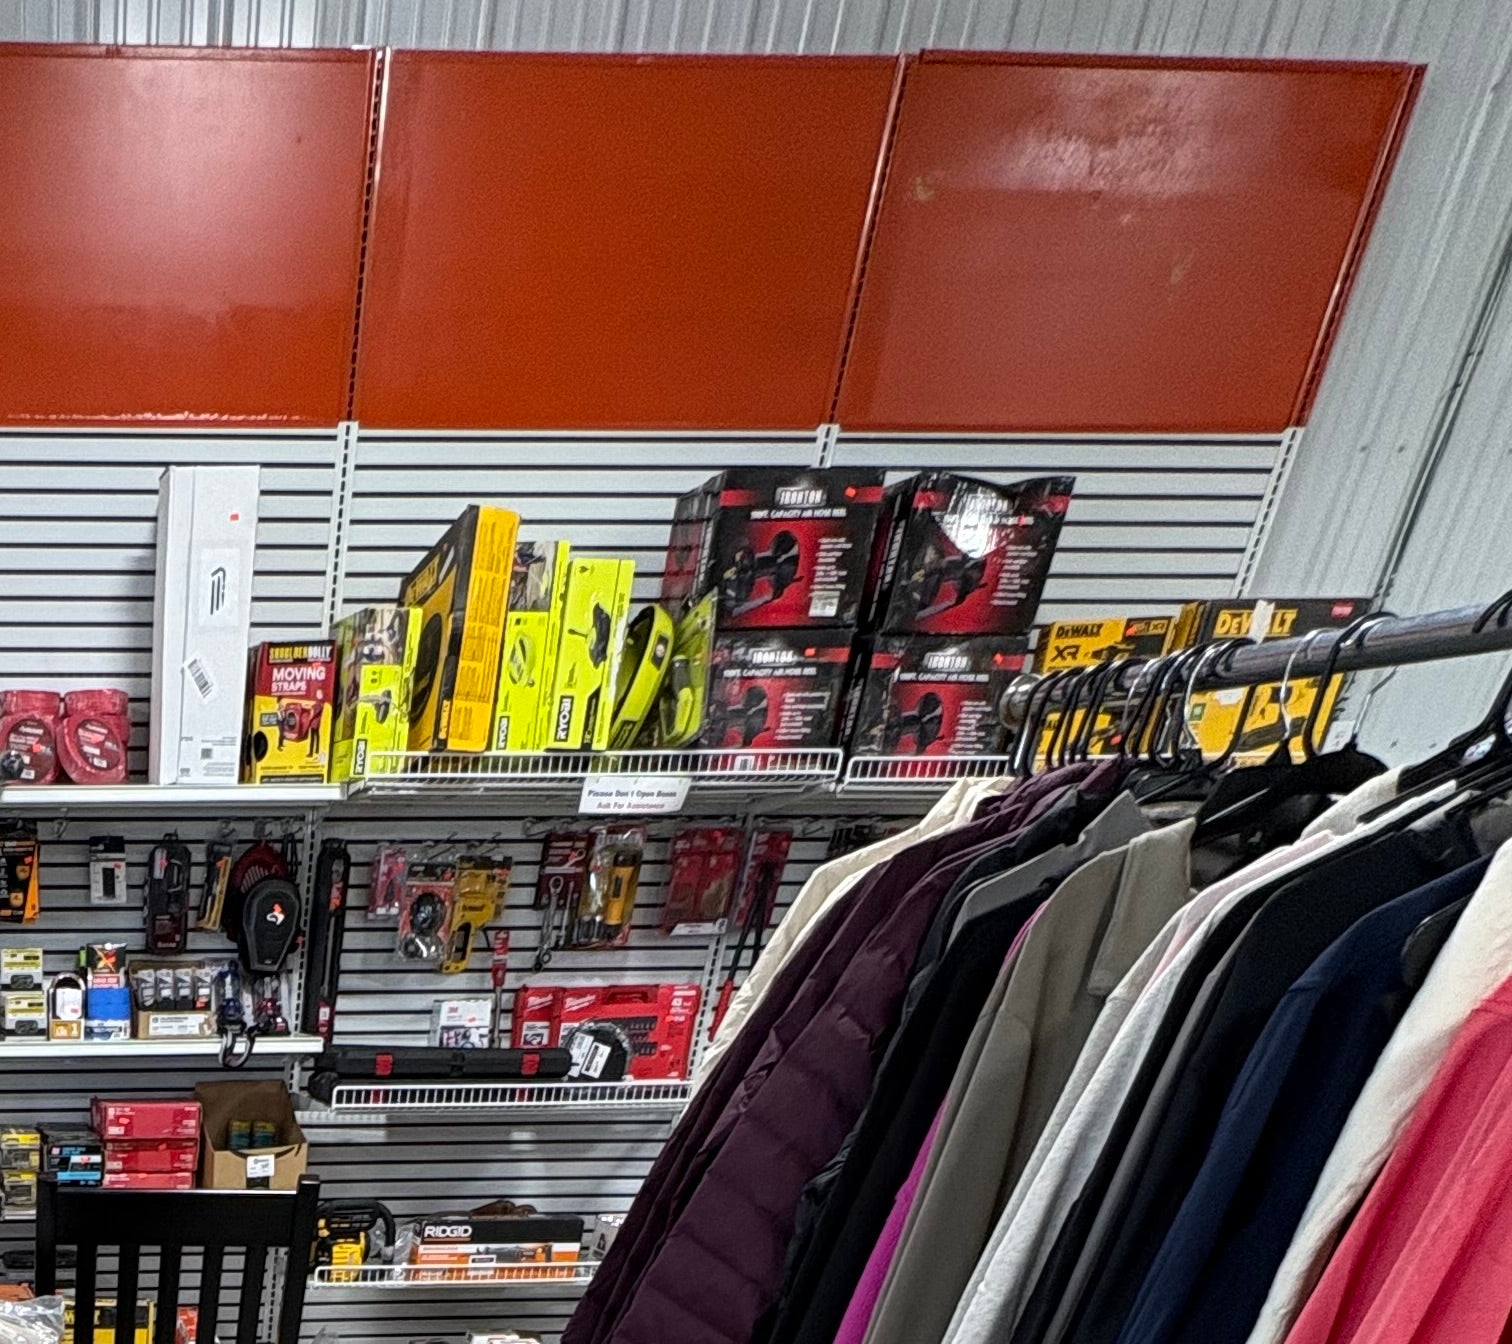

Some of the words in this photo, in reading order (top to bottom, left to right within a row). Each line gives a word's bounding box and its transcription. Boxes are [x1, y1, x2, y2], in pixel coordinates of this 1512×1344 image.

[779, 490, 823, 505] IRONTON
[1214, 611, 1299, 635] DeWLT
[1051, 646, 1081, 661] XR
[272, 667, 326, 681] MOVING
[272, 681, 306, 692] STRAPS
[557, 698, 571, 740] RYOBI
[424, 1226, 472, 1238] RIDGID
